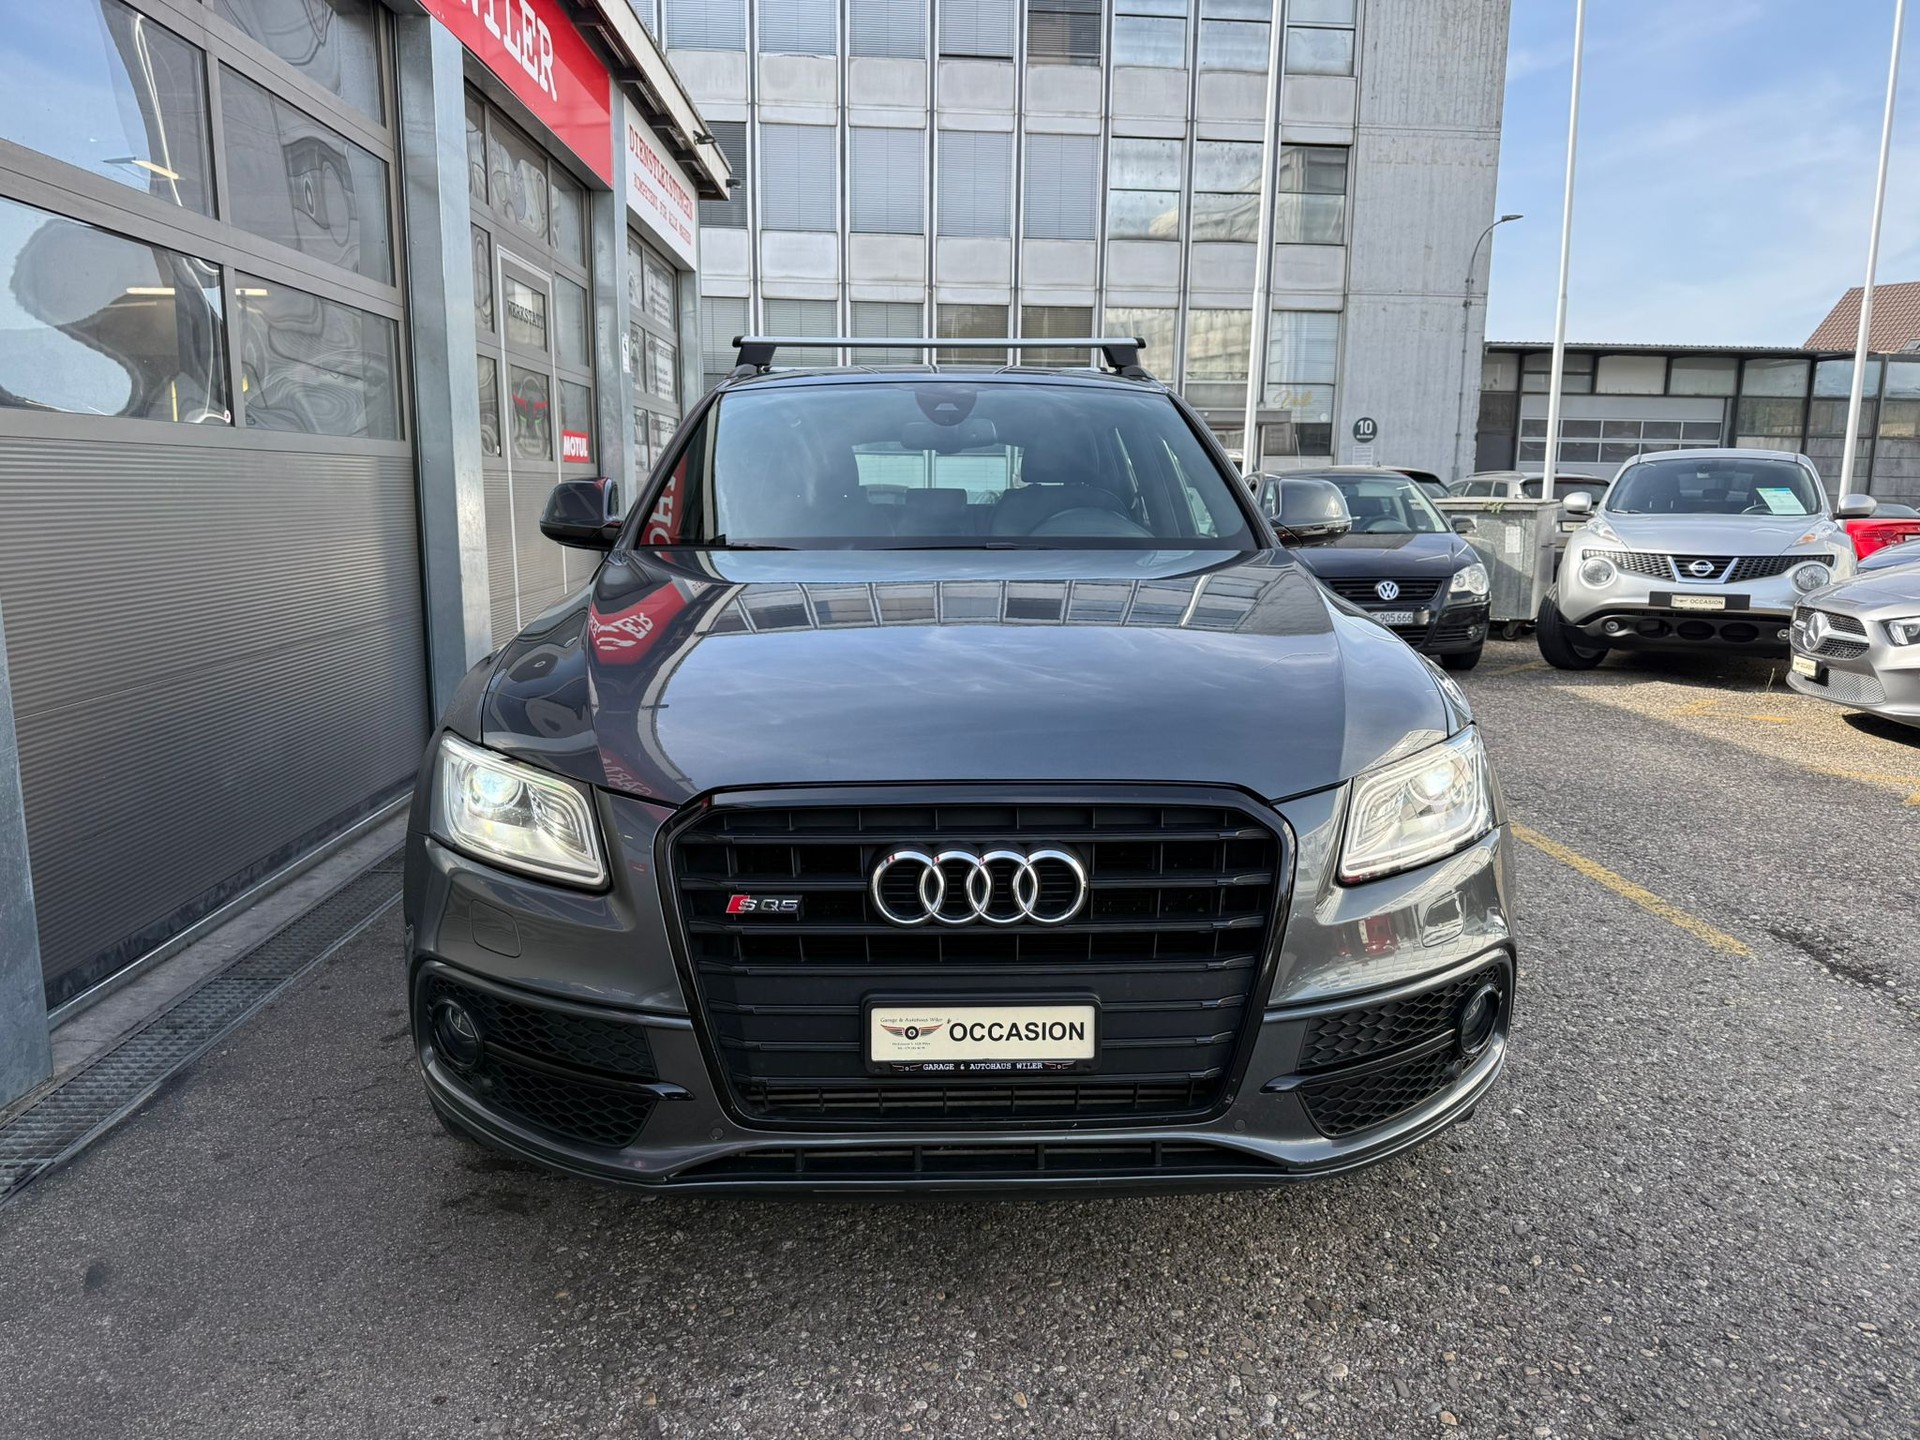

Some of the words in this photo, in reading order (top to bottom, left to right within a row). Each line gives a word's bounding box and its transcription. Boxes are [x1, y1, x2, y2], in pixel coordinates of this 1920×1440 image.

[1357, 419, 1374, 434] 10
[562, 435, 589, 457] MOTUL
[1689, 598, 1723, 606] OCCASION
[949, 1021, 1085, 1042] OCCASION
[923, 1063, 954, 1071] GARAGE
[969, 1063, 1012, 1071] AUTOHAUS
[1016, 1062, 1043, 1070] WILER
